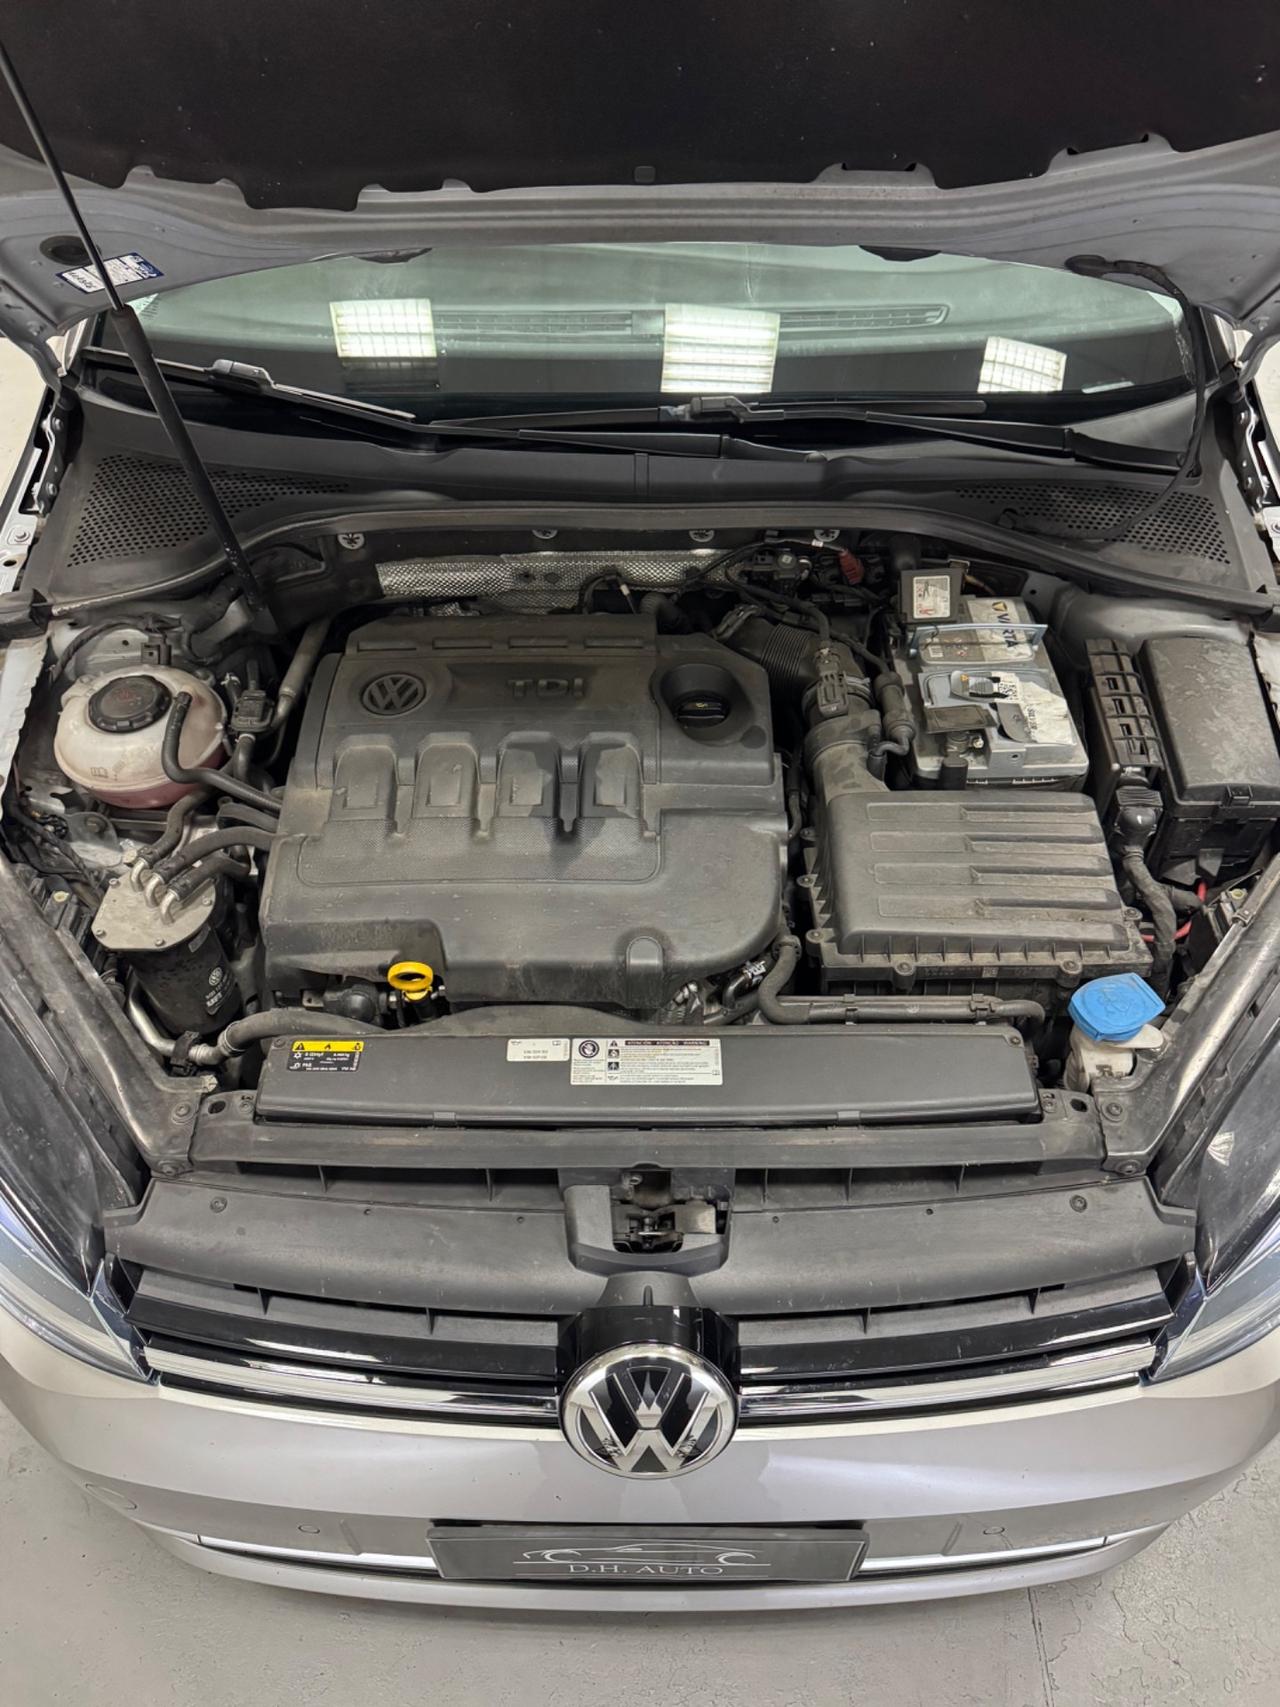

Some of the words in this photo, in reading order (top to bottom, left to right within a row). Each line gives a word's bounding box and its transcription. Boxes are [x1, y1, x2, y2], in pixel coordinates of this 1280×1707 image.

[507, 677, 584, 697] TDI
[565, 1347, 733, 1474] VW
[569, 1564, 627, 1573] D.H.
[636, 1565, 723, 1575] AUTO
